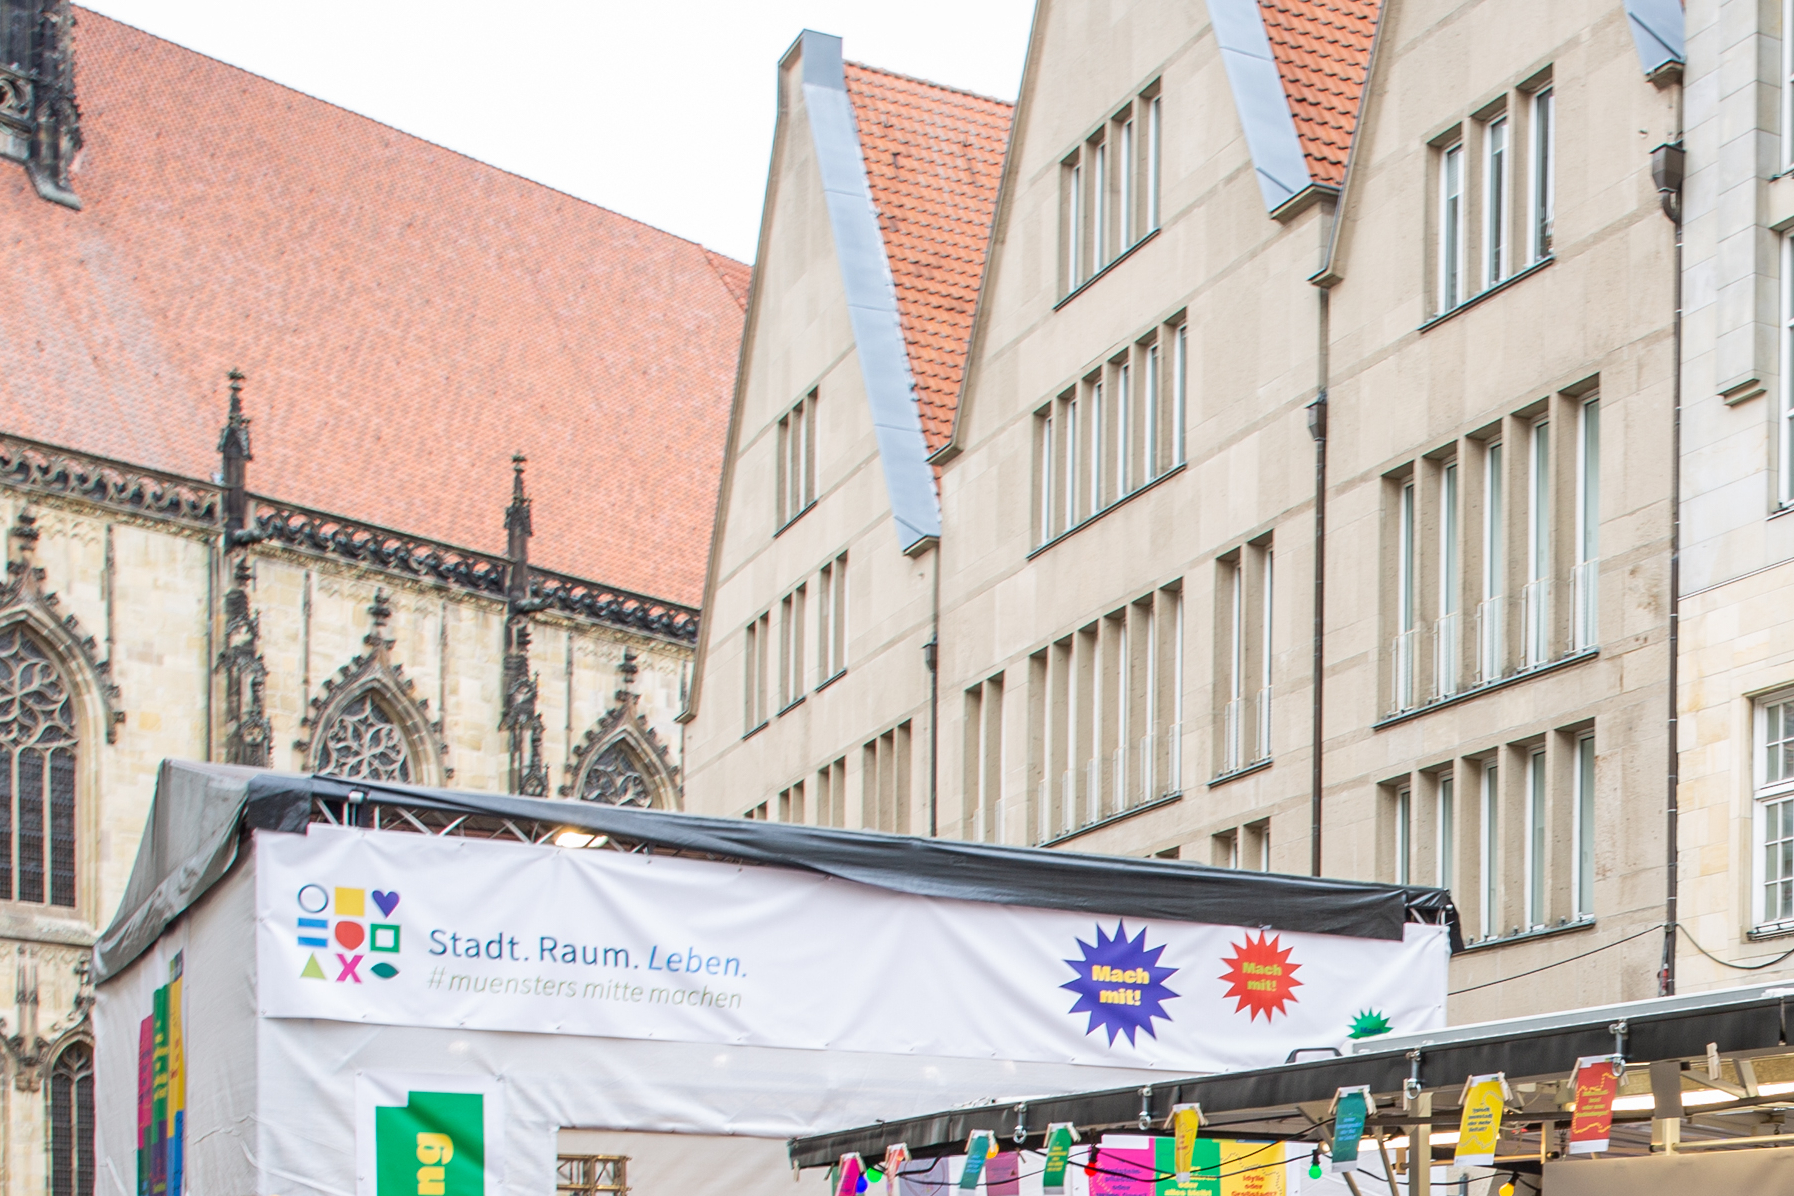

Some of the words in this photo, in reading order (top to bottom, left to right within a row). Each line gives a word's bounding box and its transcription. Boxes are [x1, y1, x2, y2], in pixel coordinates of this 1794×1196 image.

[428, 928, 529, 963] Stadt.
[539, 935, 640, 971] Raum.
[648, 944, 748, 979] Leben.
[1092, 963, 1150, 985] Mach
[1242, 961, 1283, 977] Mach
[582, 979, 644, 1003] mitte
[648, 984, 743, 1009] machen
[1247, 977, 1278, 993] mit!
[1099, 988, 1142, 1006] mit!
